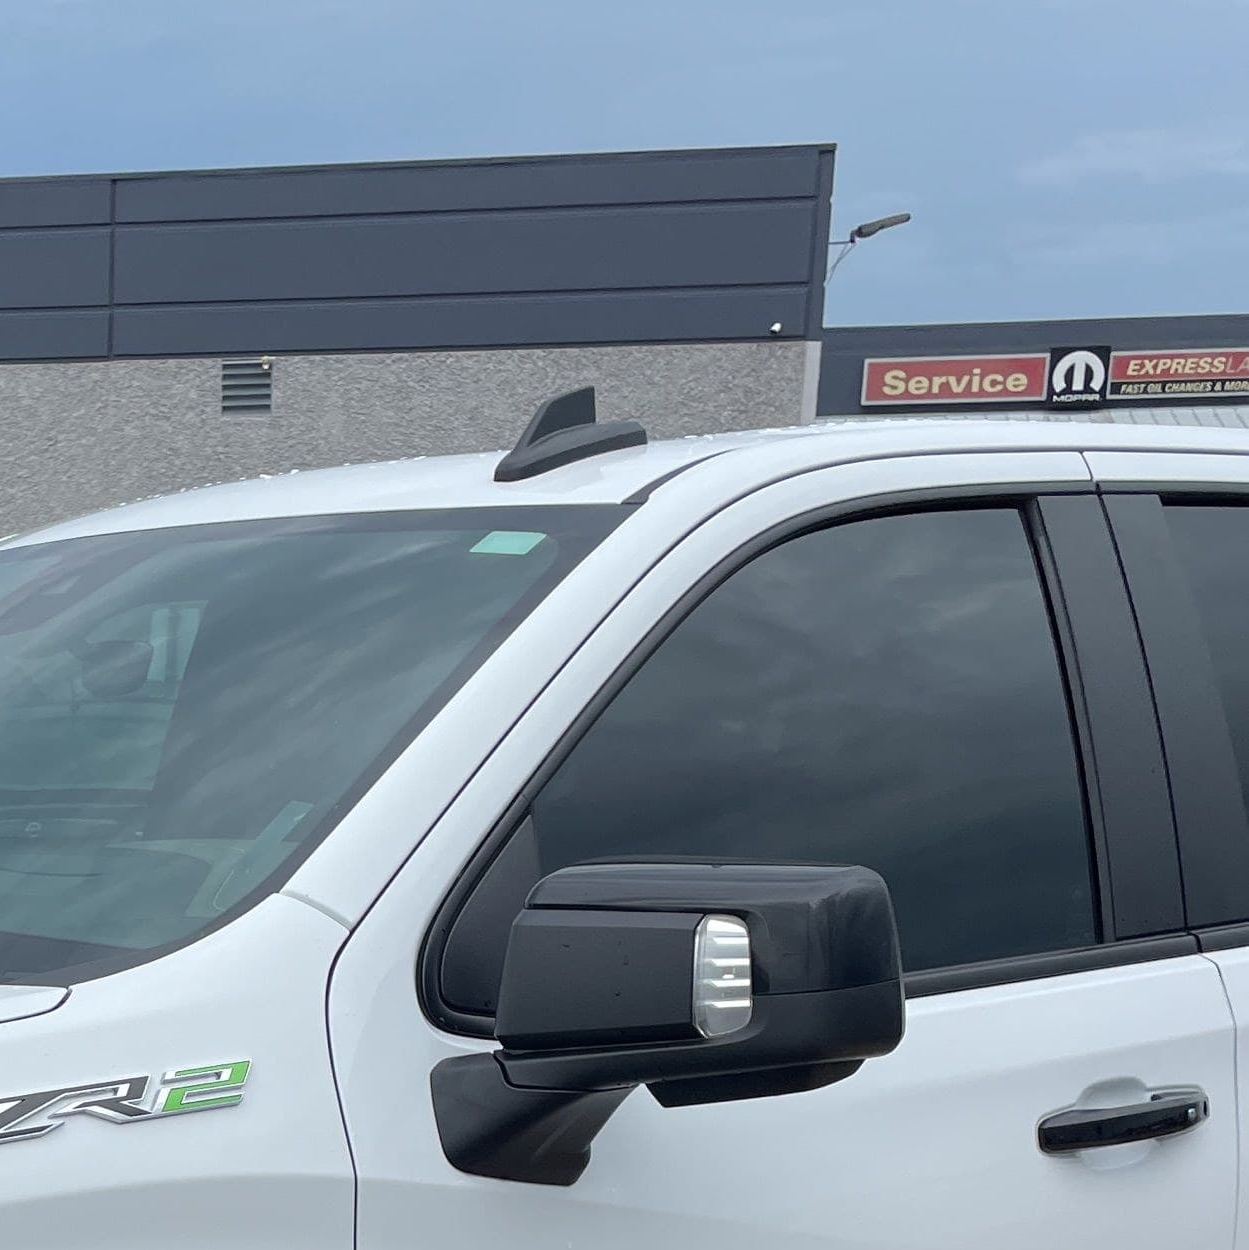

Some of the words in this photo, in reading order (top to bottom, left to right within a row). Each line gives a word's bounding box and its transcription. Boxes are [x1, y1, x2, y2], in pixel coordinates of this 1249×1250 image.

[882, 368, 1028, 395] Service
[1120, 384, 1146, 394] FAST
[1147, 383, 1163, 392] OIL
[1165, 382, 1213, 392] CHANGES
[1214, 381, 1222, 391] &
[1224, 381, 1249, 391] MOR
[1053, 394, 1100, 402] MOPAR
